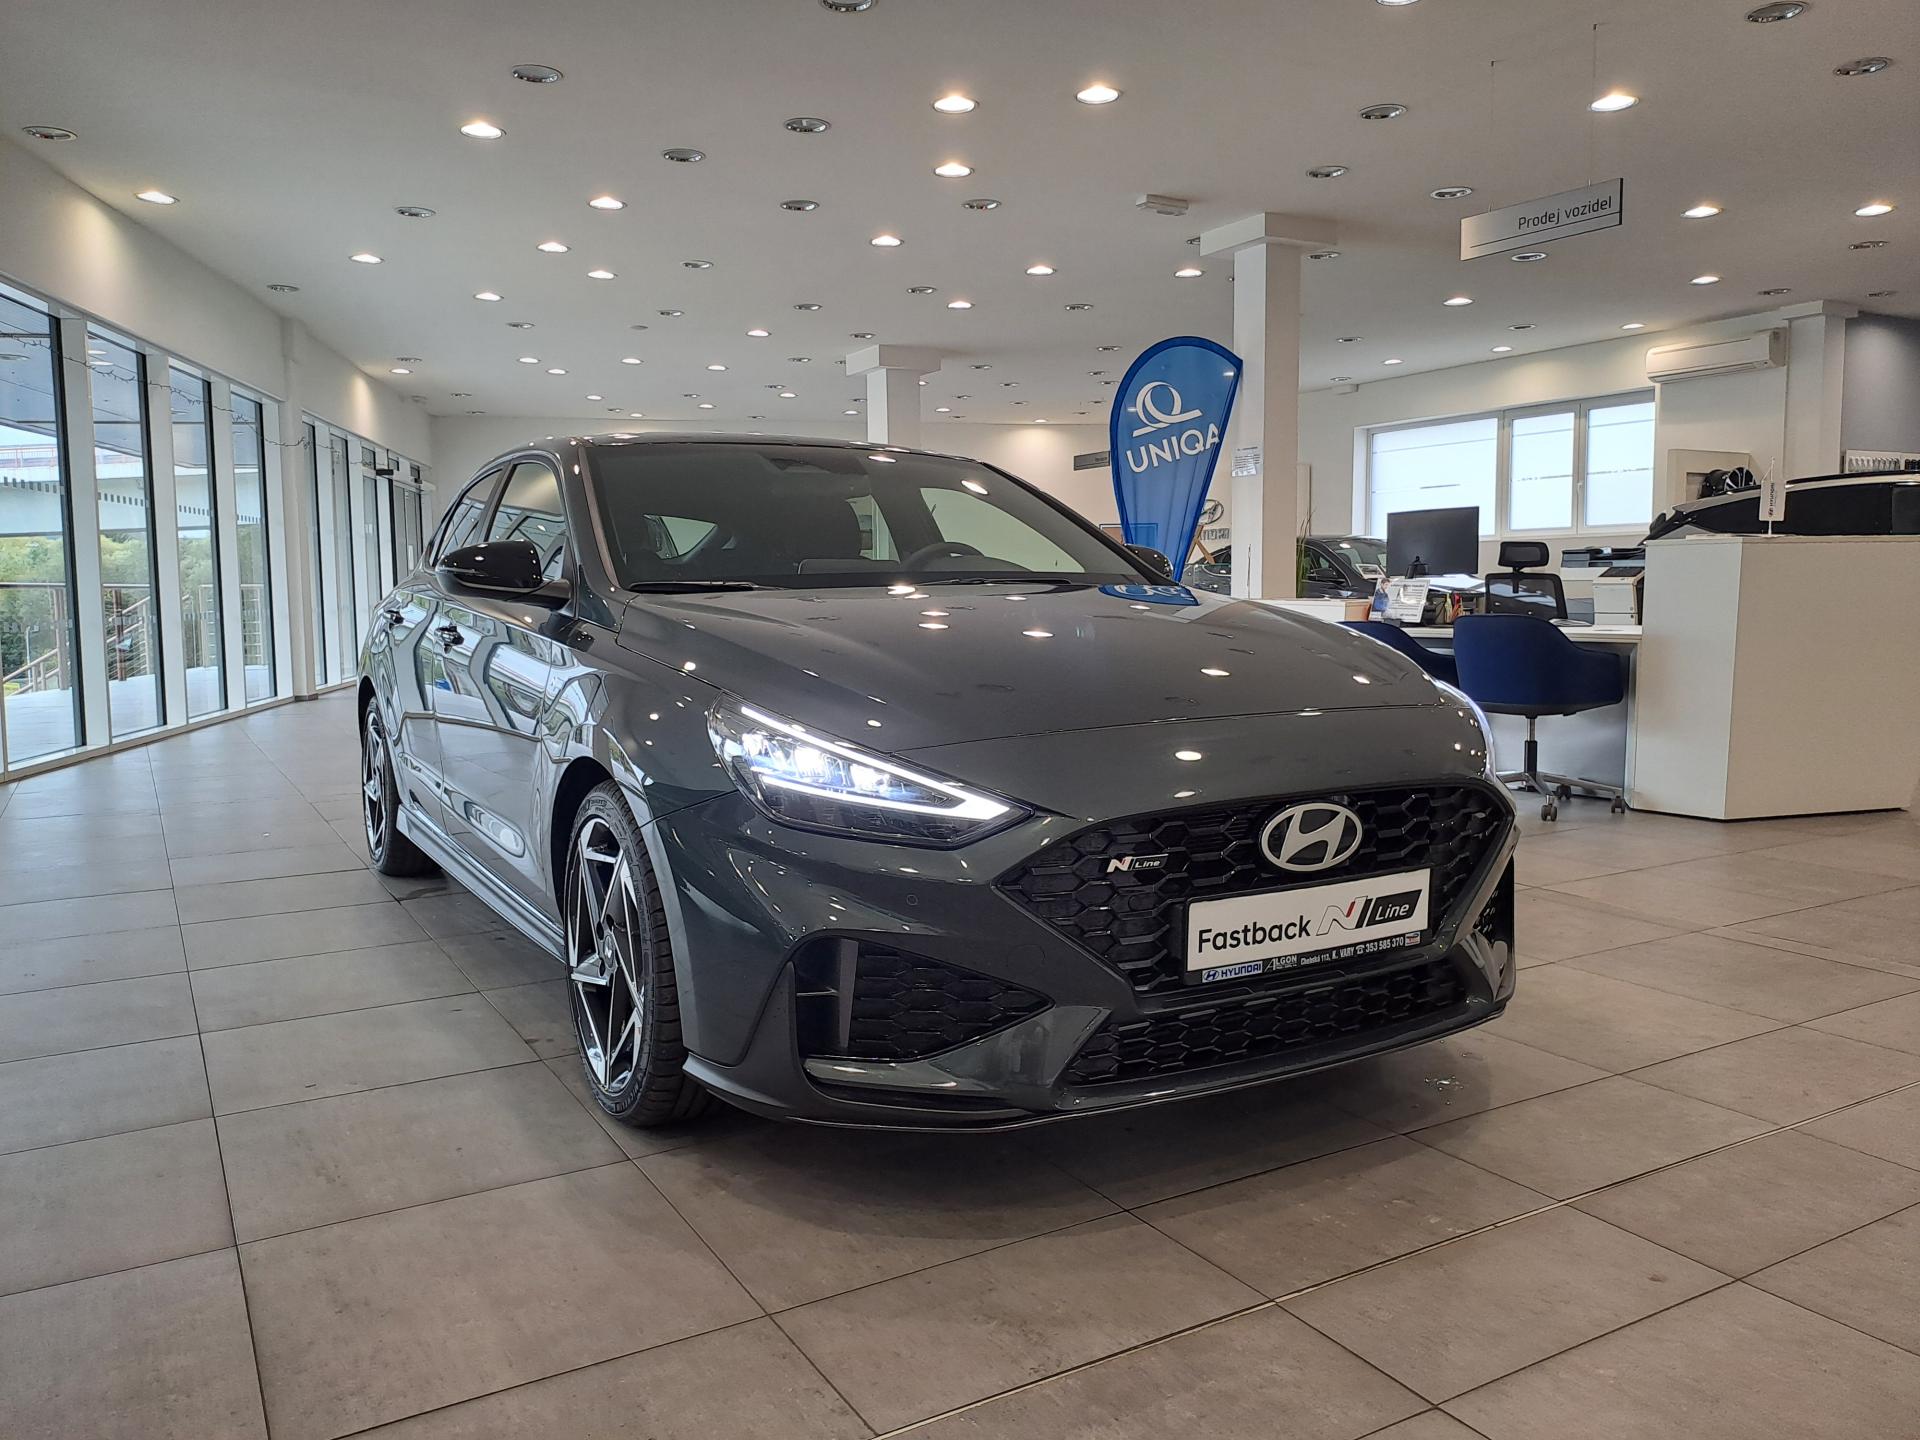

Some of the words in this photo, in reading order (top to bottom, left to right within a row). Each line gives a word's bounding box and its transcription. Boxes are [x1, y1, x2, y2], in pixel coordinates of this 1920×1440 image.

[1518, 208, 1560, 230] Prodej
[1565, 195, 1612, 219] vozidel
[1126, 423, 1220, 473] UNIQA
[1107, 856, 1133, 873] N
[1135, 860, 1161, 869] Line
[1198, 914, 1311, 954] Fastback
[1375, 901, 1410, 922] Line
[1221, 963, 1261, 978] HYUNDAI
[1264, 955, 1297, 972] ALGON
[1365, 943, 1378, 953] 353
[1379, 939, 1391, 951] 585
[1392, 936, 1404, 948] 370
